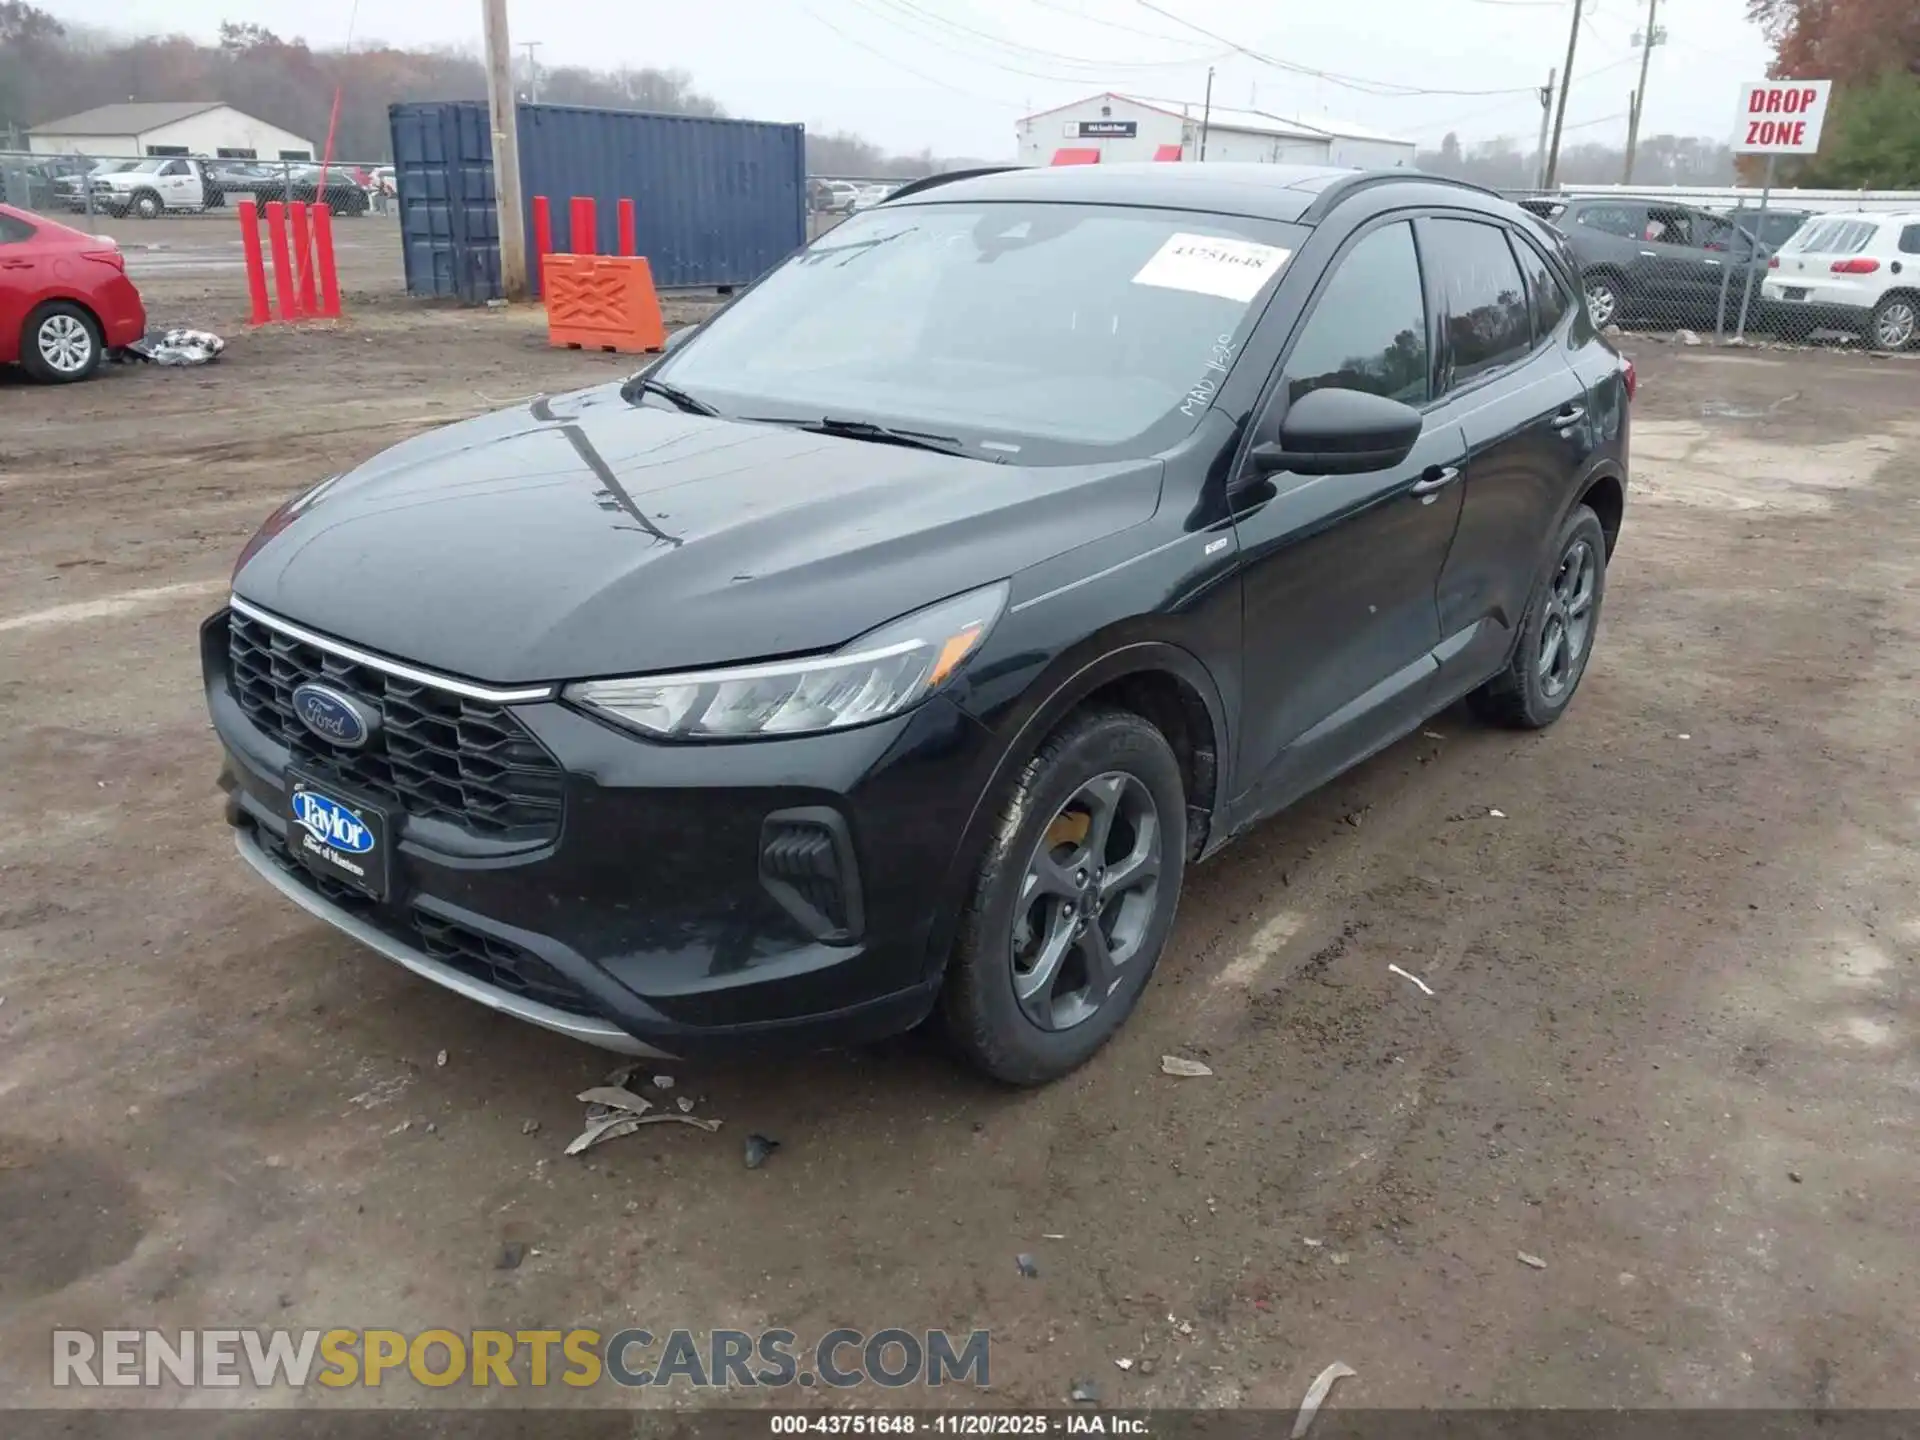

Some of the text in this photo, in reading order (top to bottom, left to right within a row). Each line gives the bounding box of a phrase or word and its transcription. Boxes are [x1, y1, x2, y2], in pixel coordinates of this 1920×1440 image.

[1748, 88, 1817, 113] DROP
[1745, 121, 1806, 145] ZONE
[305, 697, 345, 736] Ford
[297, 792, 364, 848] Taylor
